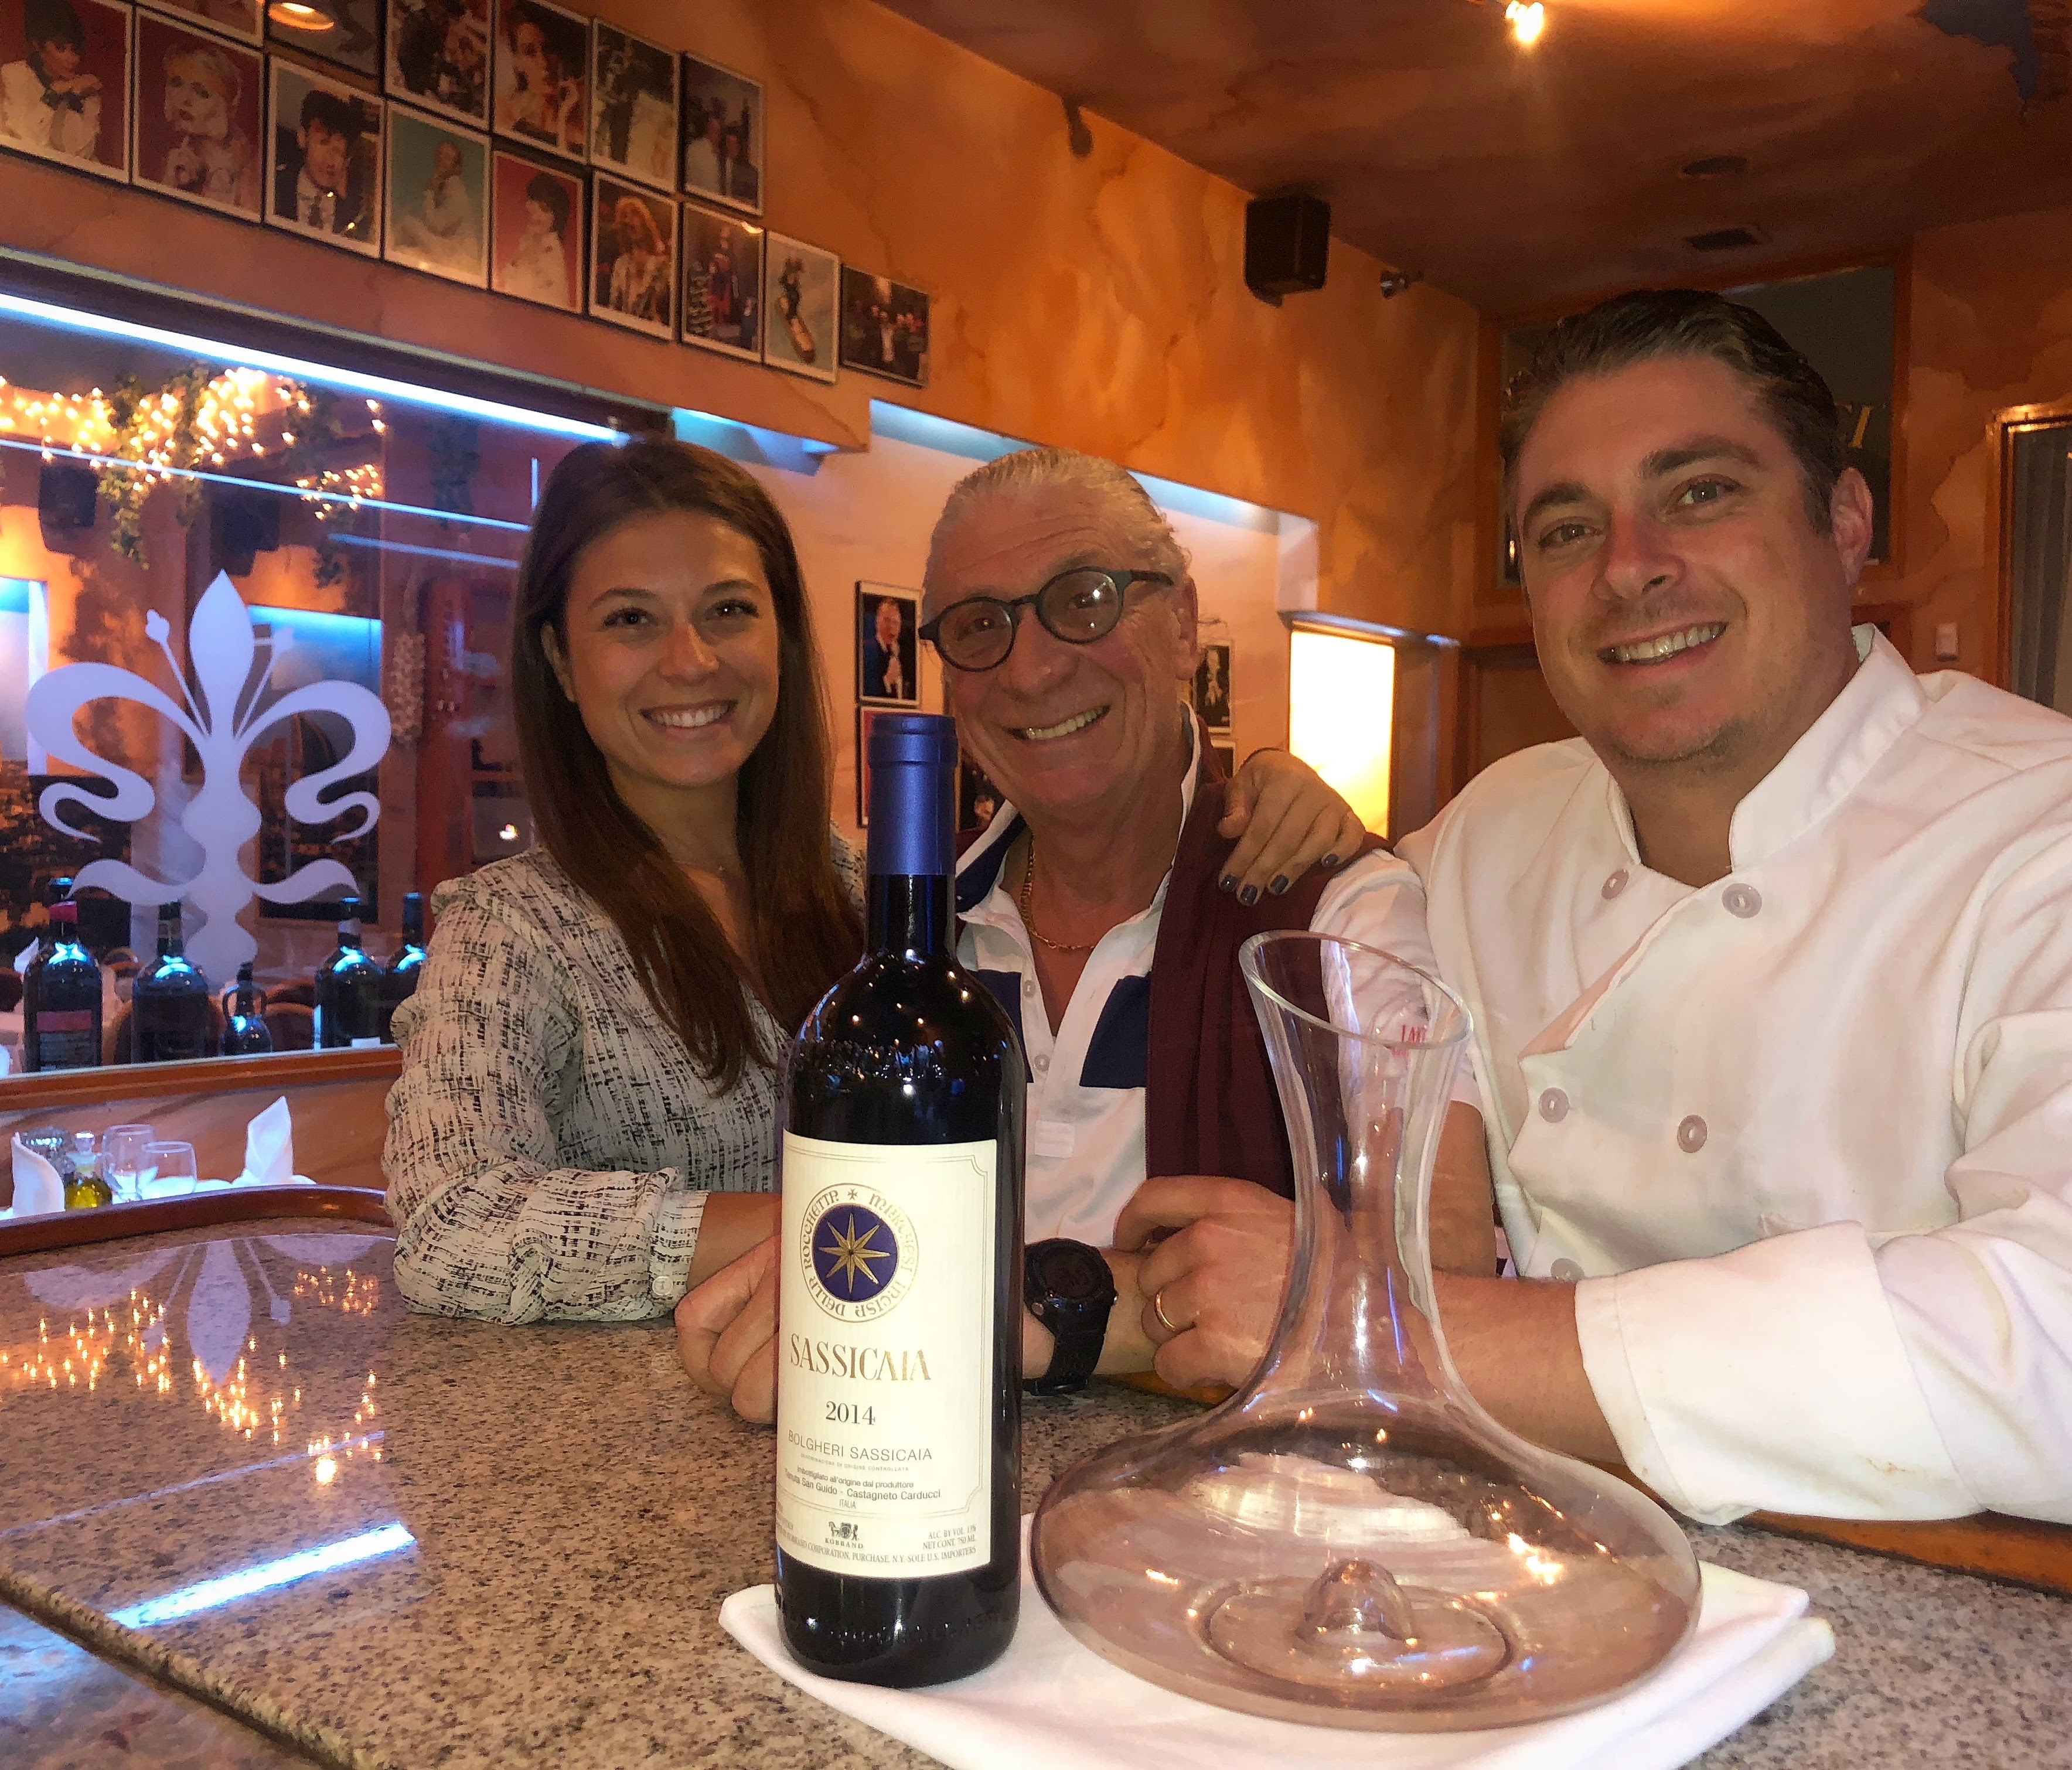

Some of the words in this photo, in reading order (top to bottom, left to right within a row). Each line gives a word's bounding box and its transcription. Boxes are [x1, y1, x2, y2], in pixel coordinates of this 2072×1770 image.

[790, 1332, 931, 1381] SASSICAIA
[826, 1400, 875, 1425] 2014
[788, 1429, 843, 1457] BOLGHERI
[850, 1447, 932, 1461] SASSICAIA
[802, 1478, 814, 1489] San
[816, 1482, 837, 1495] Guido
[847, 1488, 898, 1501] Castagneto
[901, 1489, 940, 1500] Carducci
[839, 1499, 856, 1509] ITALIA
[825, 1537, 863, 1549] KOBRAND
[923, 1541, 935, 1550] NET
[941, 1546, 976, 1560] IMPORTERS
